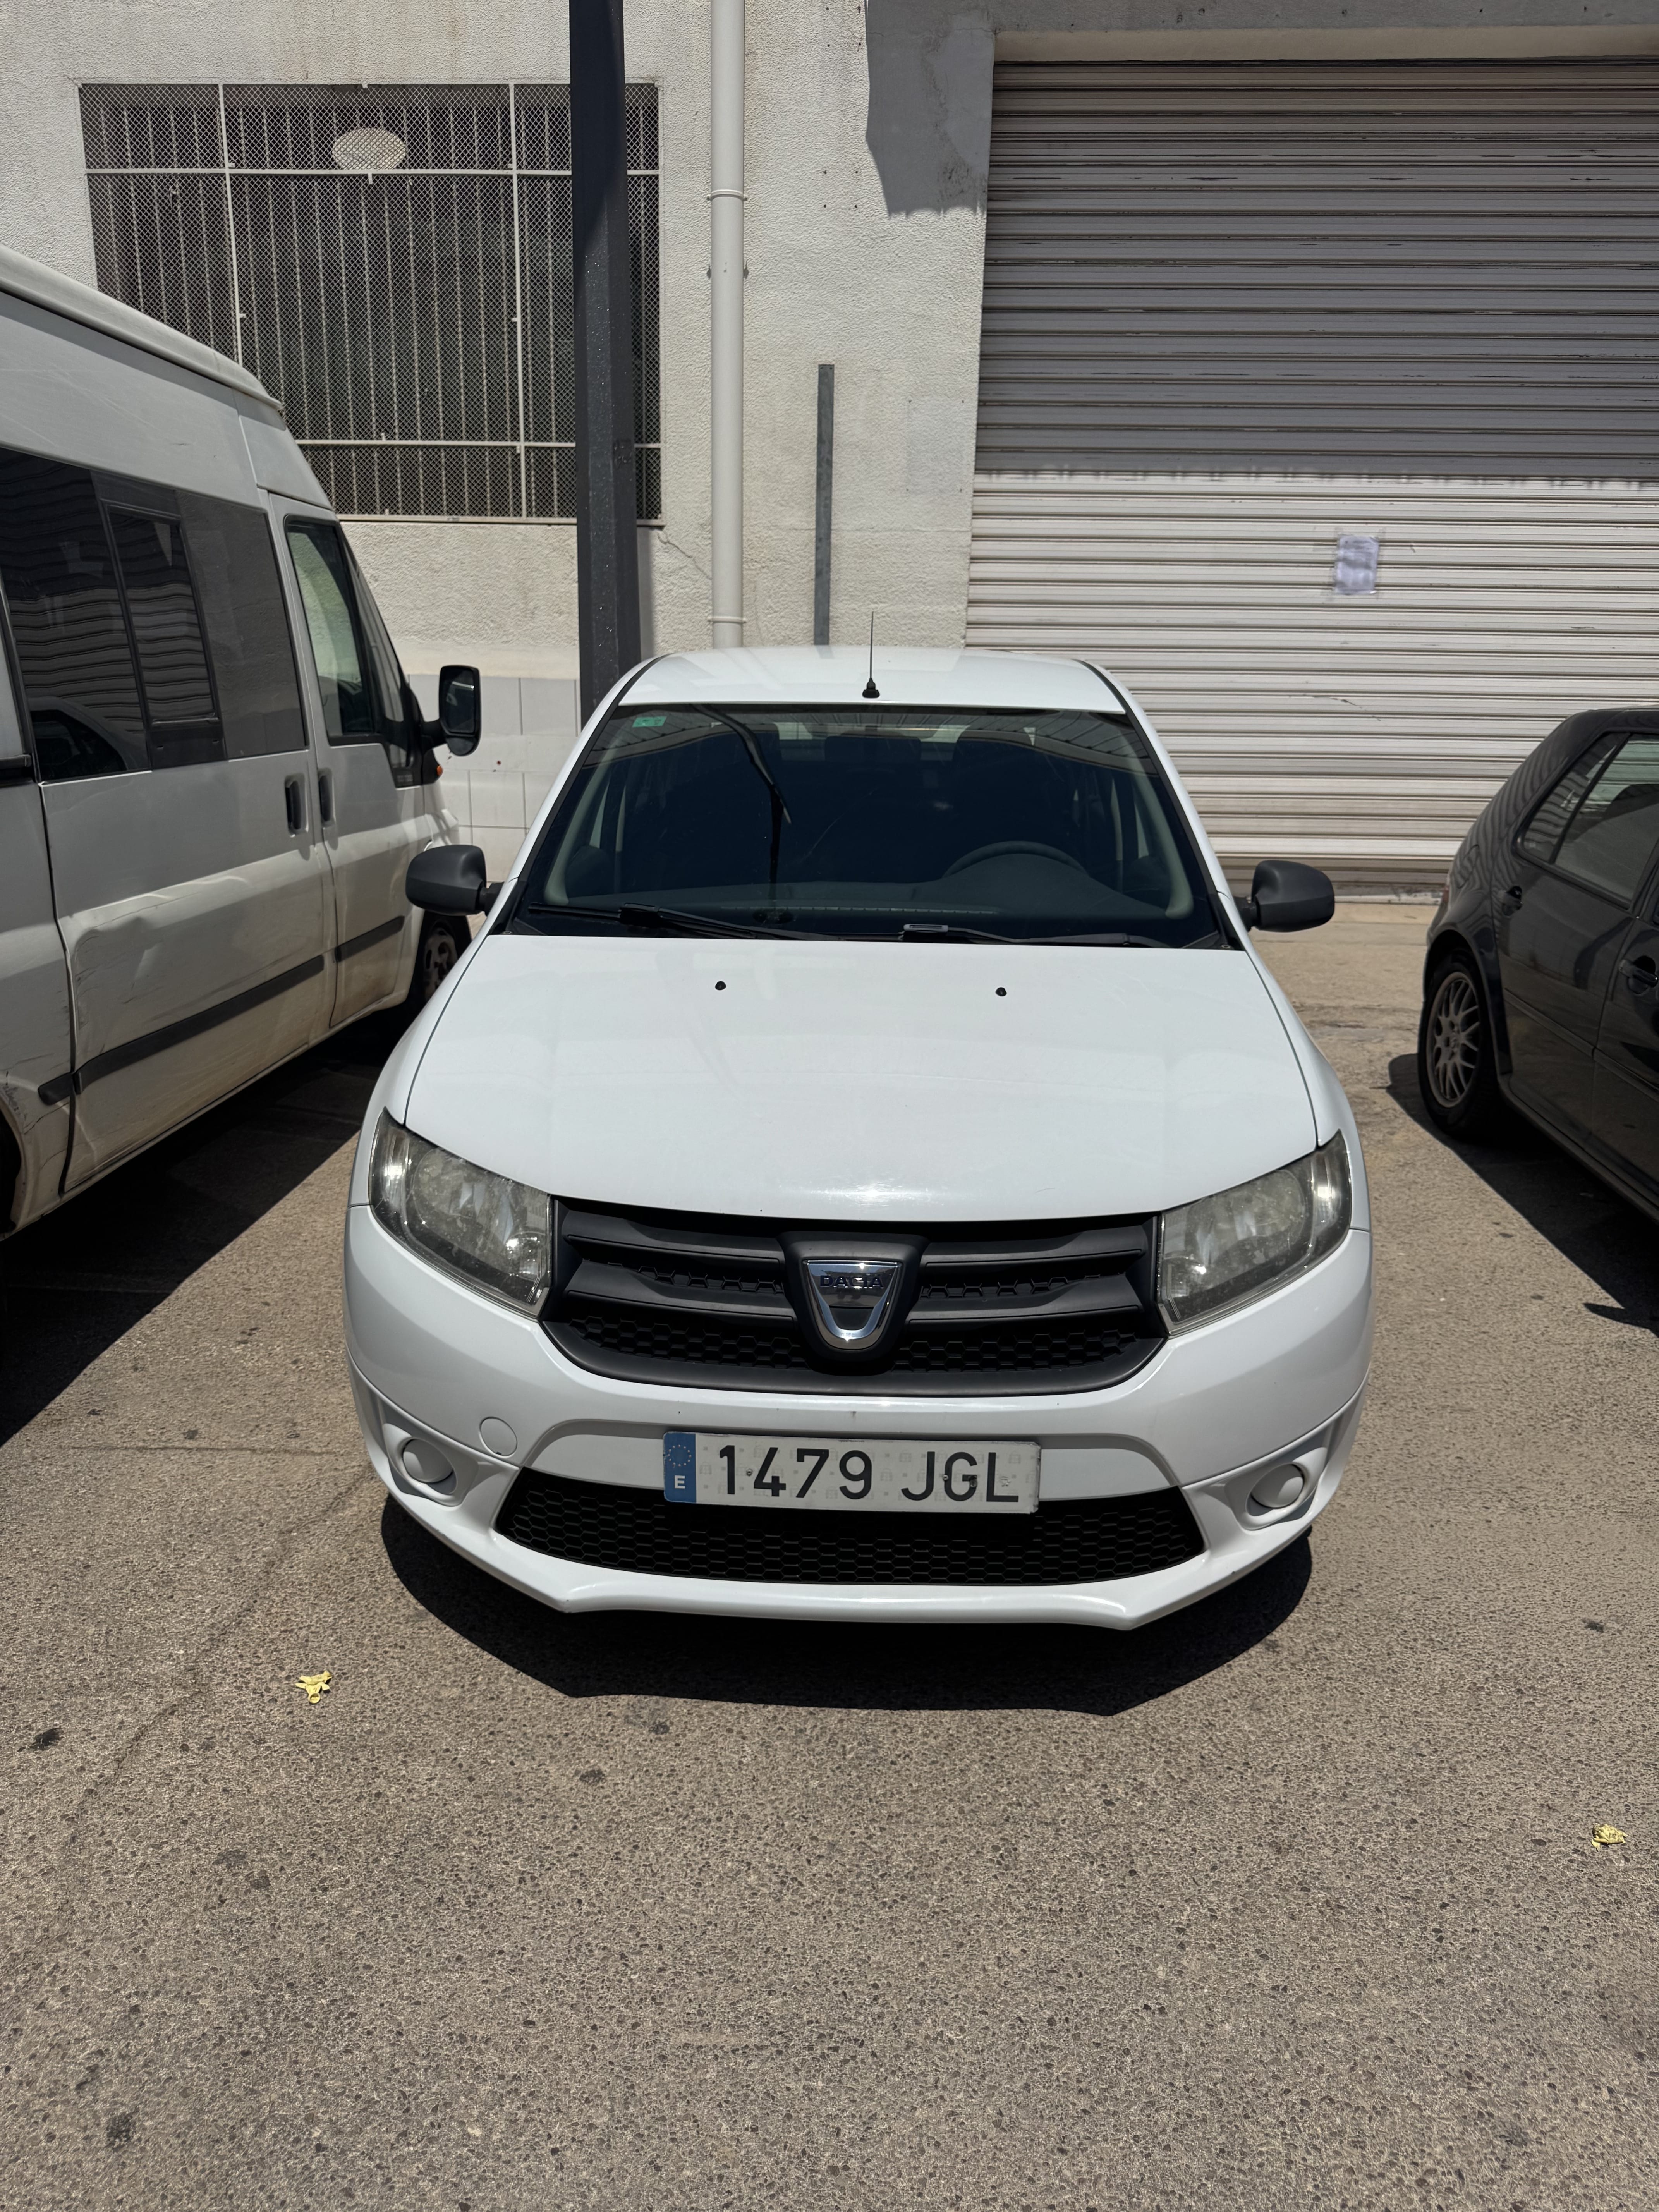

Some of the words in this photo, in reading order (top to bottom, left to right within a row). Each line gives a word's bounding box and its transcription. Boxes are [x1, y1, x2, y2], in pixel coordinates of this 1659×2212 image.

[820, 1275, 884, 1289] DACIA
[720, 1445, 872, 1500] 1479
[901, 1451, 1019, 1502] JGL
[675, 1475, 685, 1489] E
